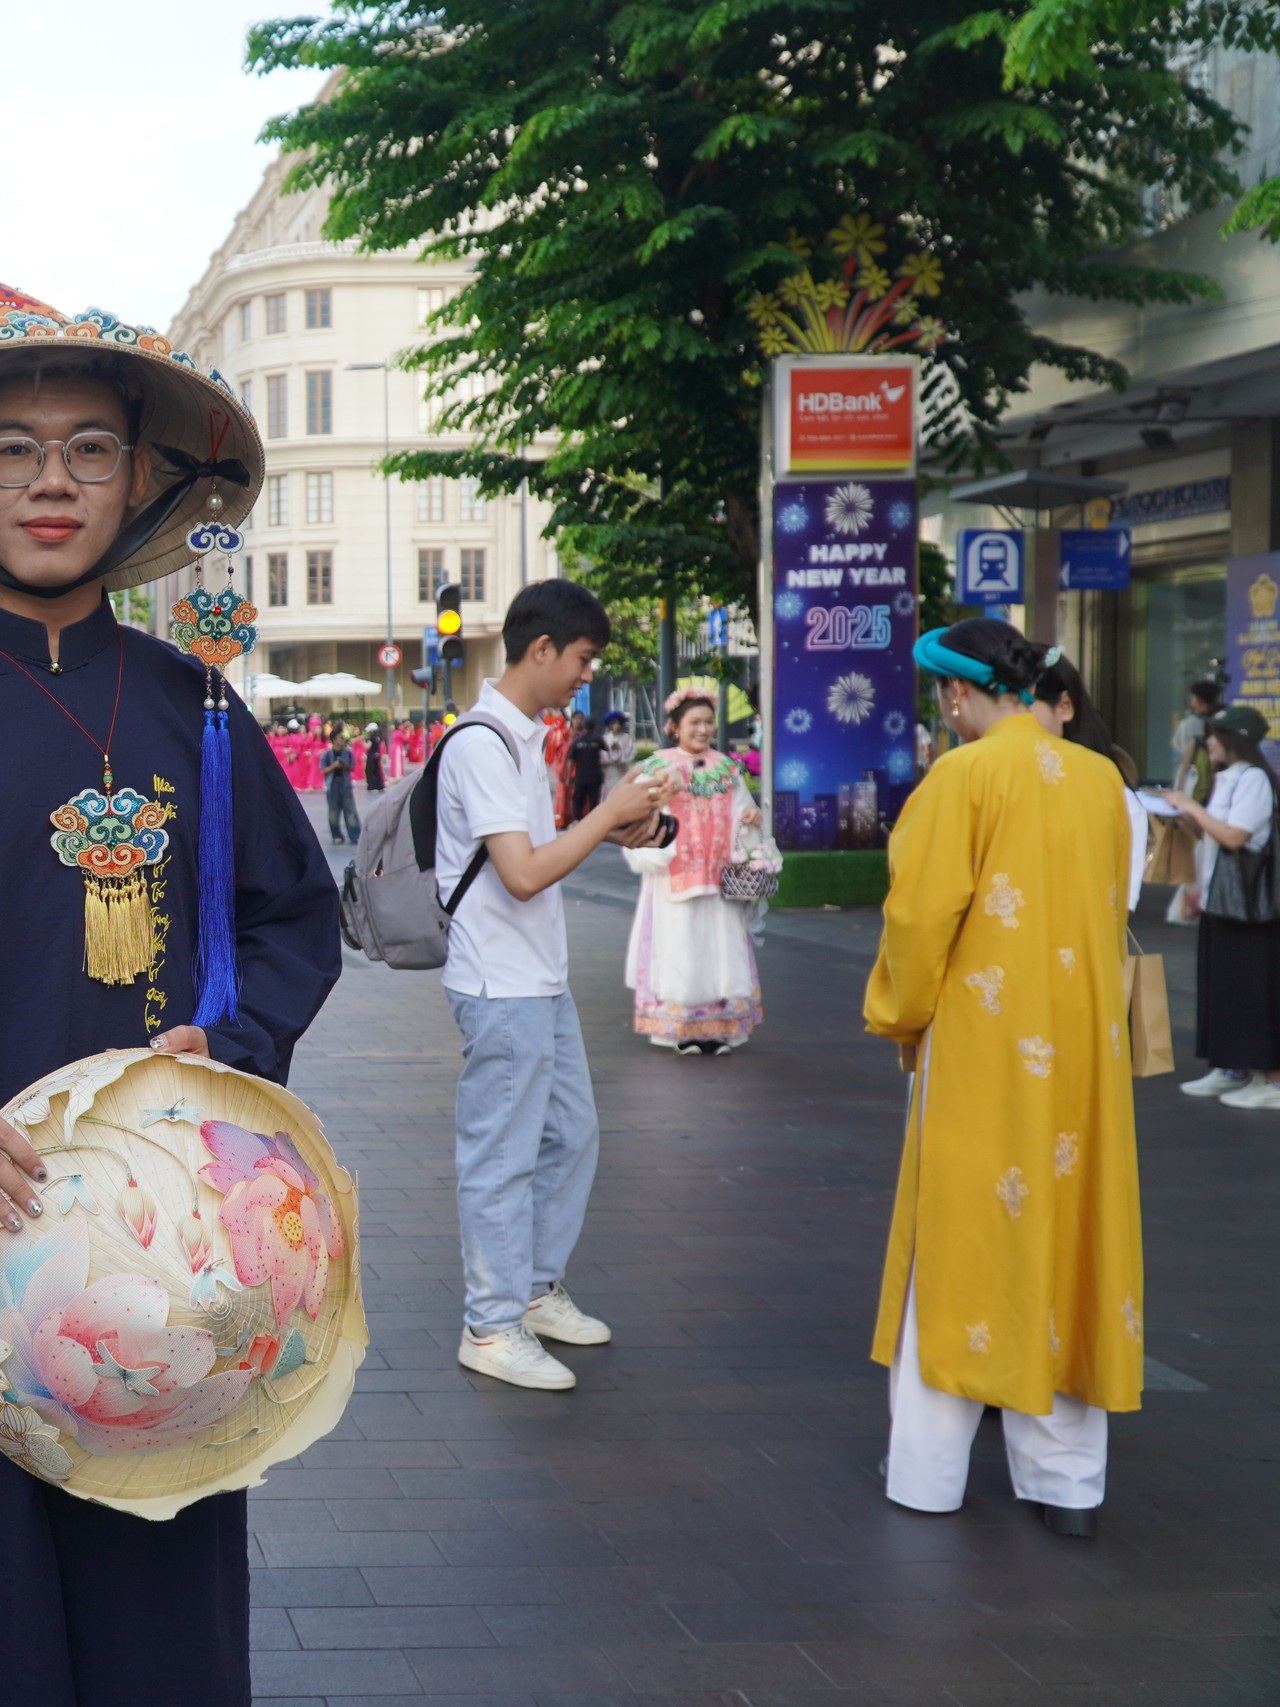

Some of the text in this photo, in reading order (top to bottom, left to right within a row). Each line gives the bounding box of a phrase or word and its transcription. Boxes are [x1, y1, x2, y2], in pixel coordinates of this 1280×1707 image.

[798, 392, 882, 412] HDBank
[810, 543, 888, 563] HAPPY
[787, 567, 906, 588] NEW YEAR
[806, 604, 892, 651] 2025
